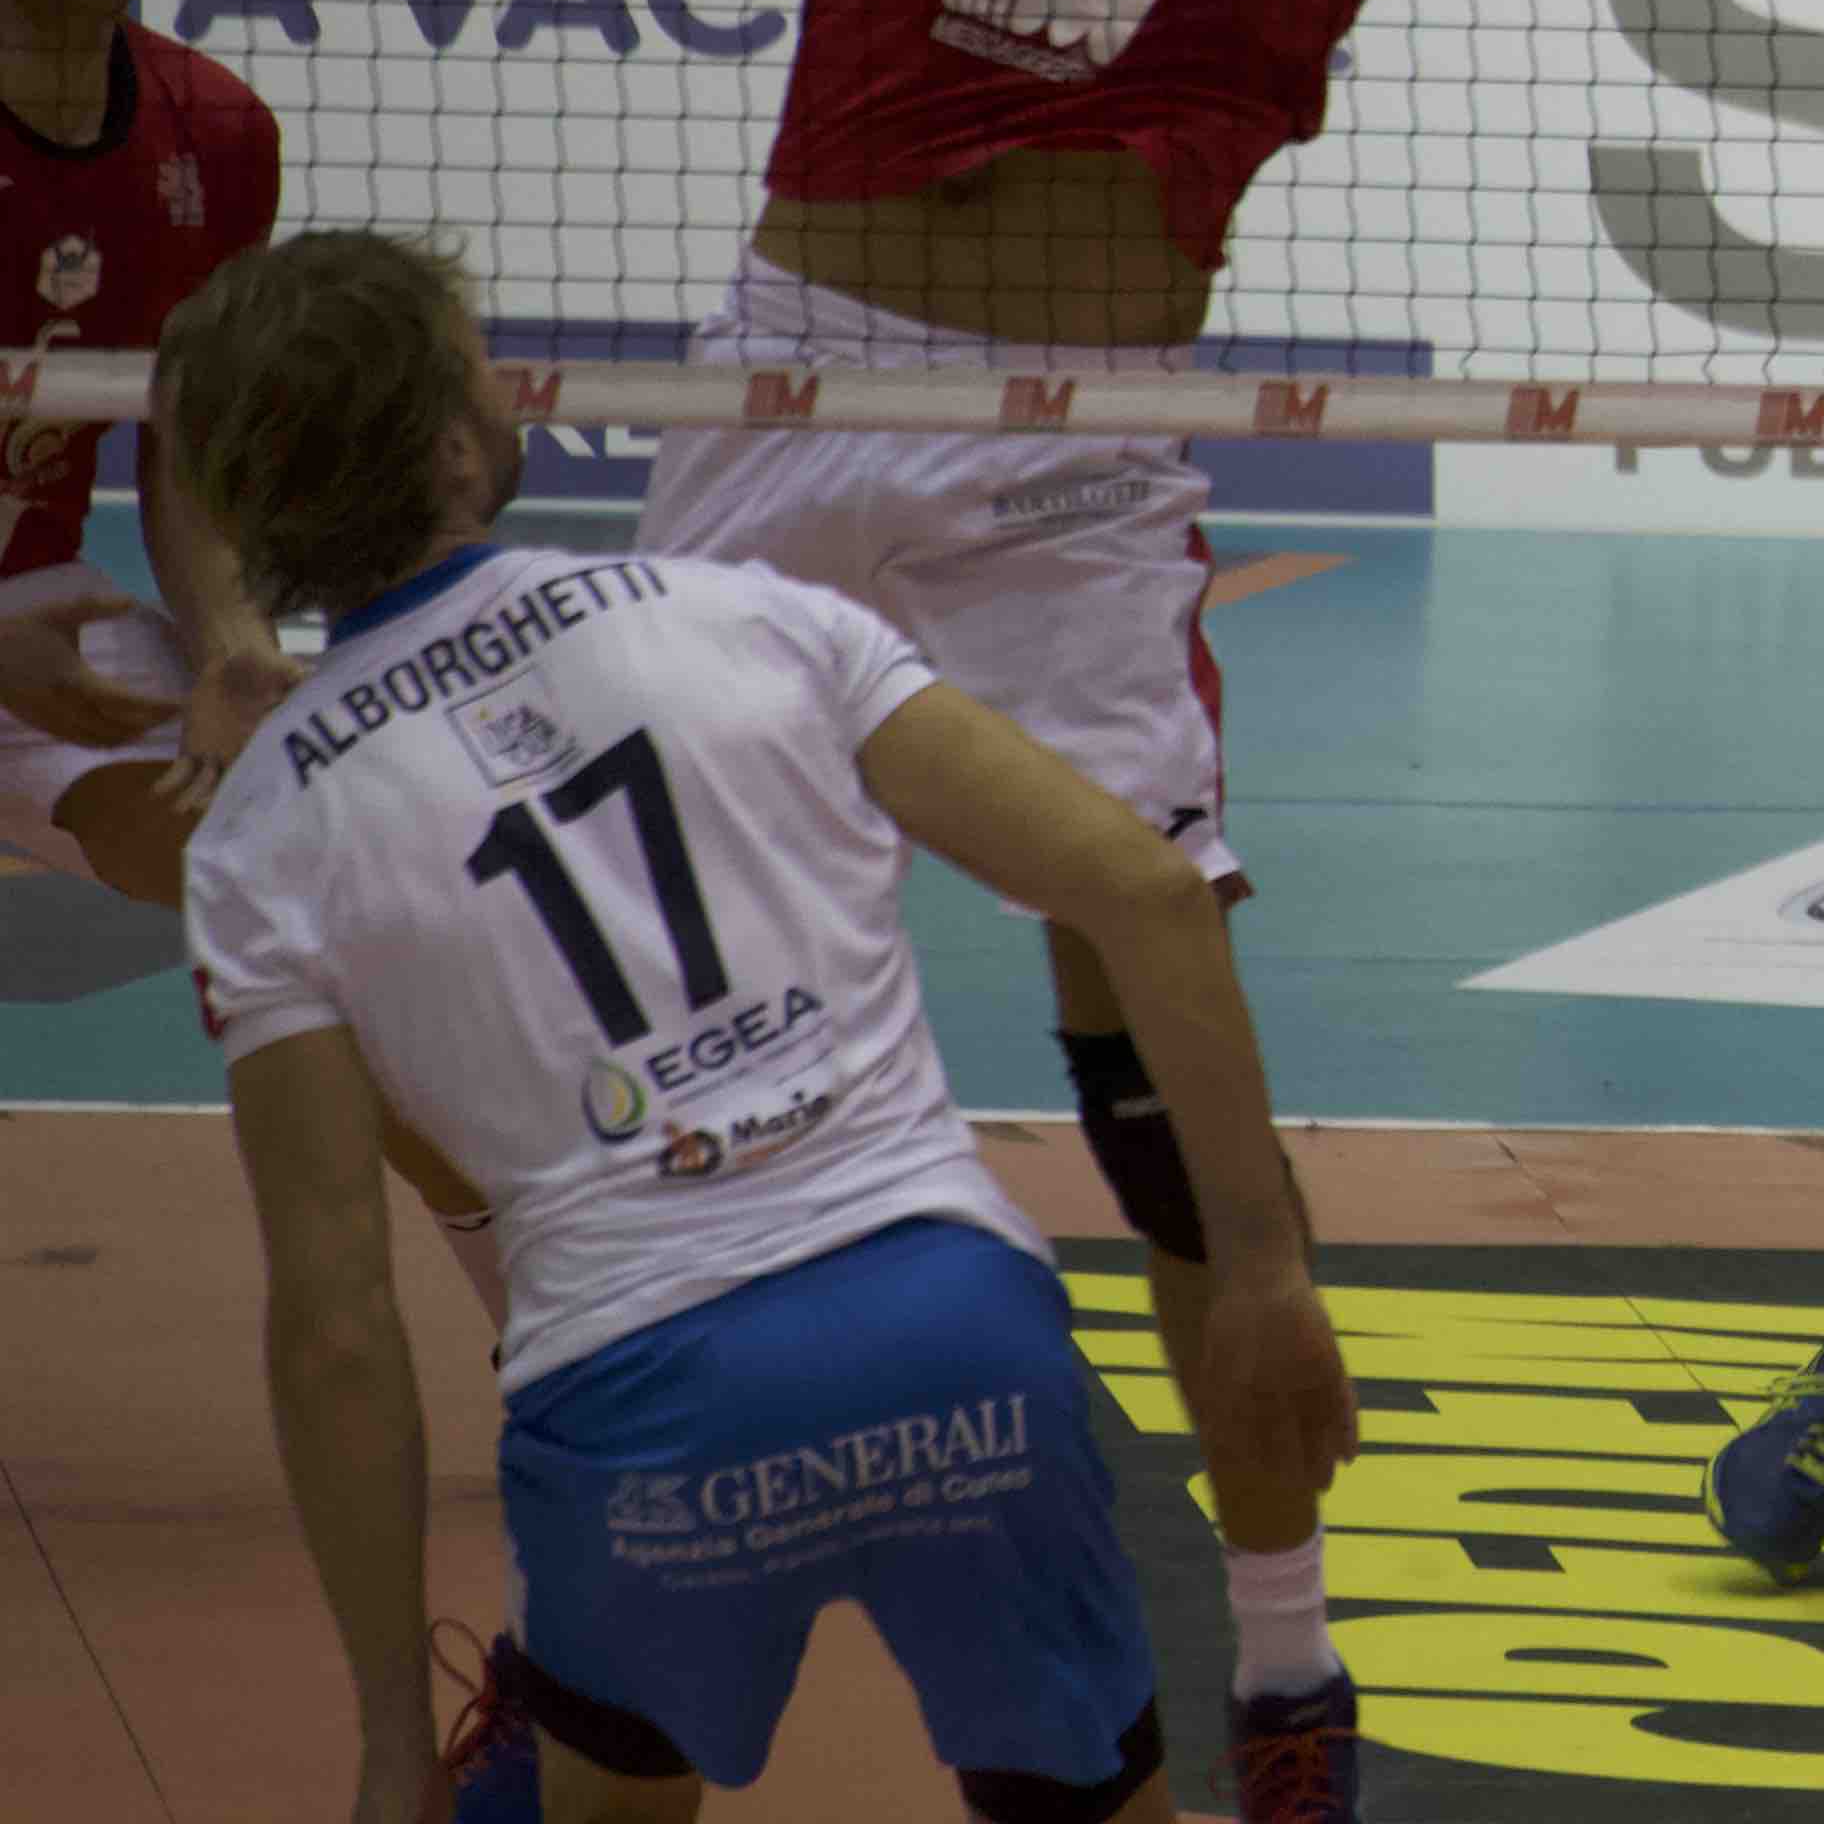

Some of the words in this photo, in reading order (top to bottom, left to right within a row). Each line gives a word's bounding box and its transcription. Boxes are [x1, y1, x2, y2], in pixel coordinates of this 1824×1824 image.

[283, 561, 668, 786] ALBORGHETTI
[466, 727, 728, 1049] 17
[645, 986, 824, 1092] EGEA
[701, 1391, 1029, 1525] GENERALI
